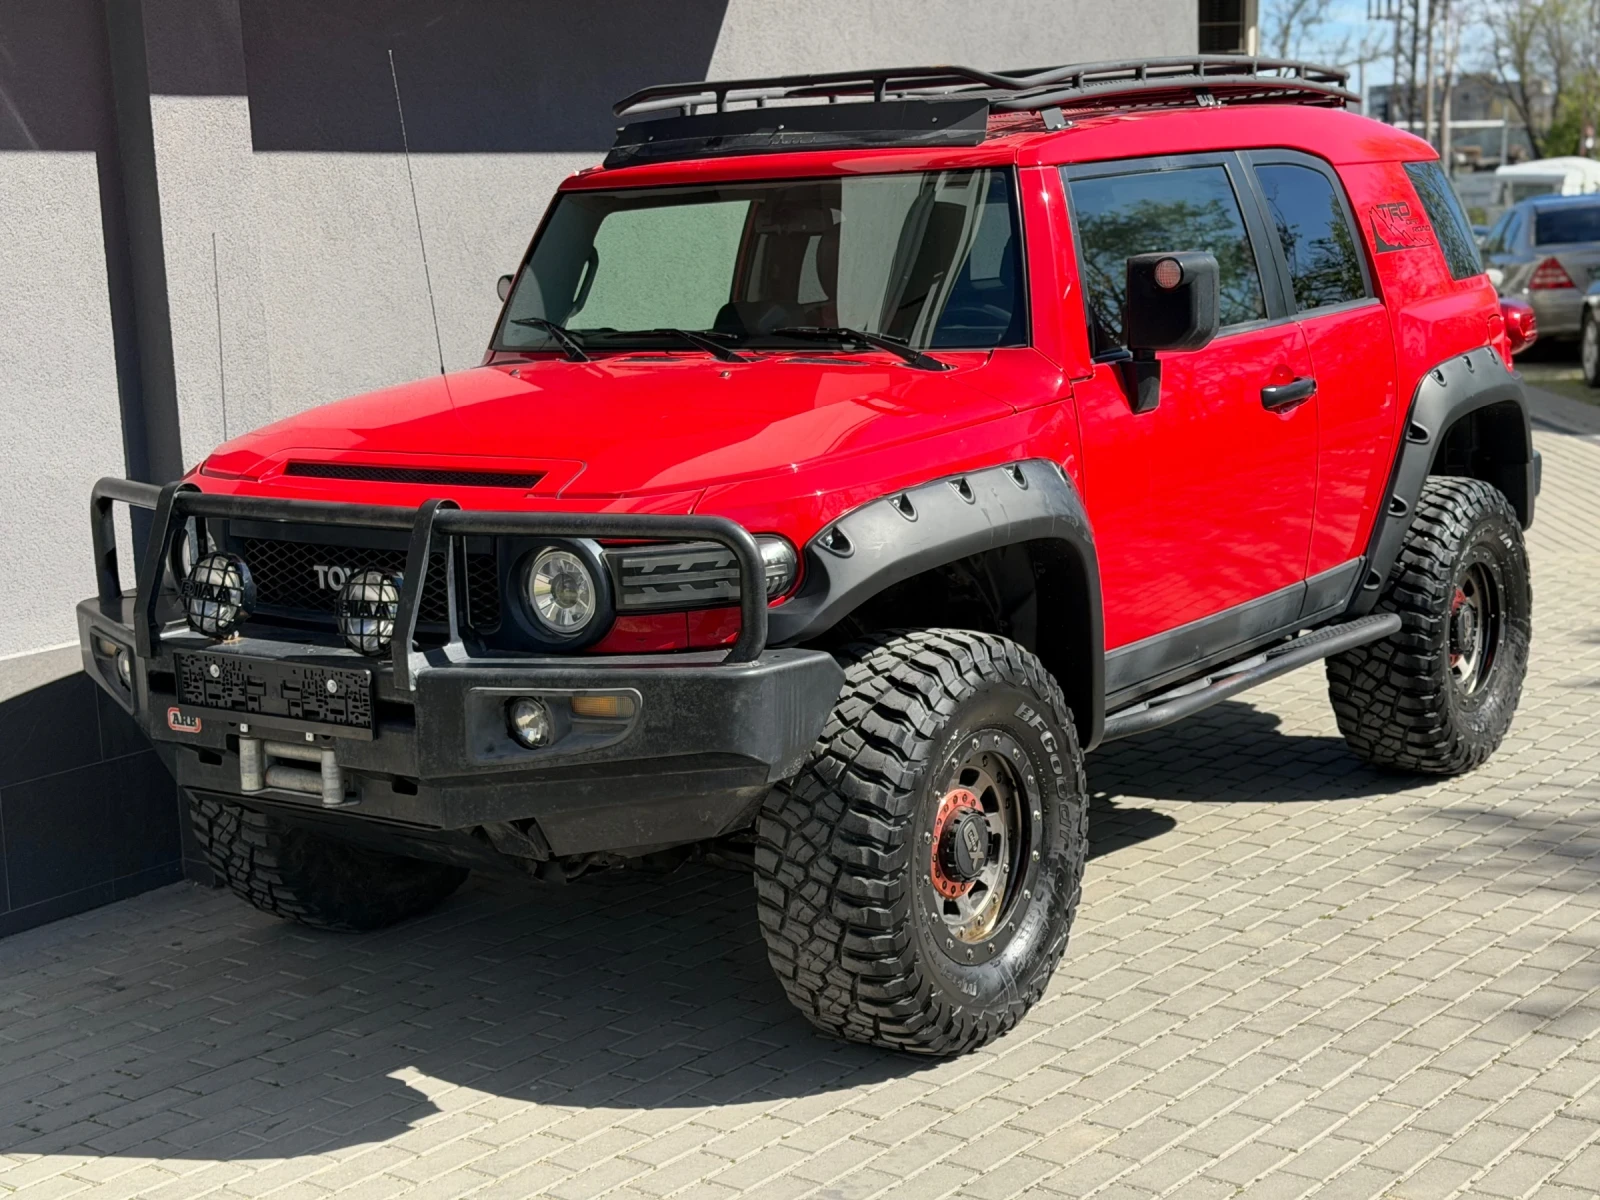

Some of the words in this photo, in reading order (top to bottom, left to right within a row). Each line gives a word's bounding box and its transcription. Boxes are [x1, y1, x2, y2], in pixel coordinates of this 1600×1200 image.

[1376, 202, 1410, 223] TRD
[1412, 225, 1431, 233] ROAD
[172, 712, 197, 727] ARB
